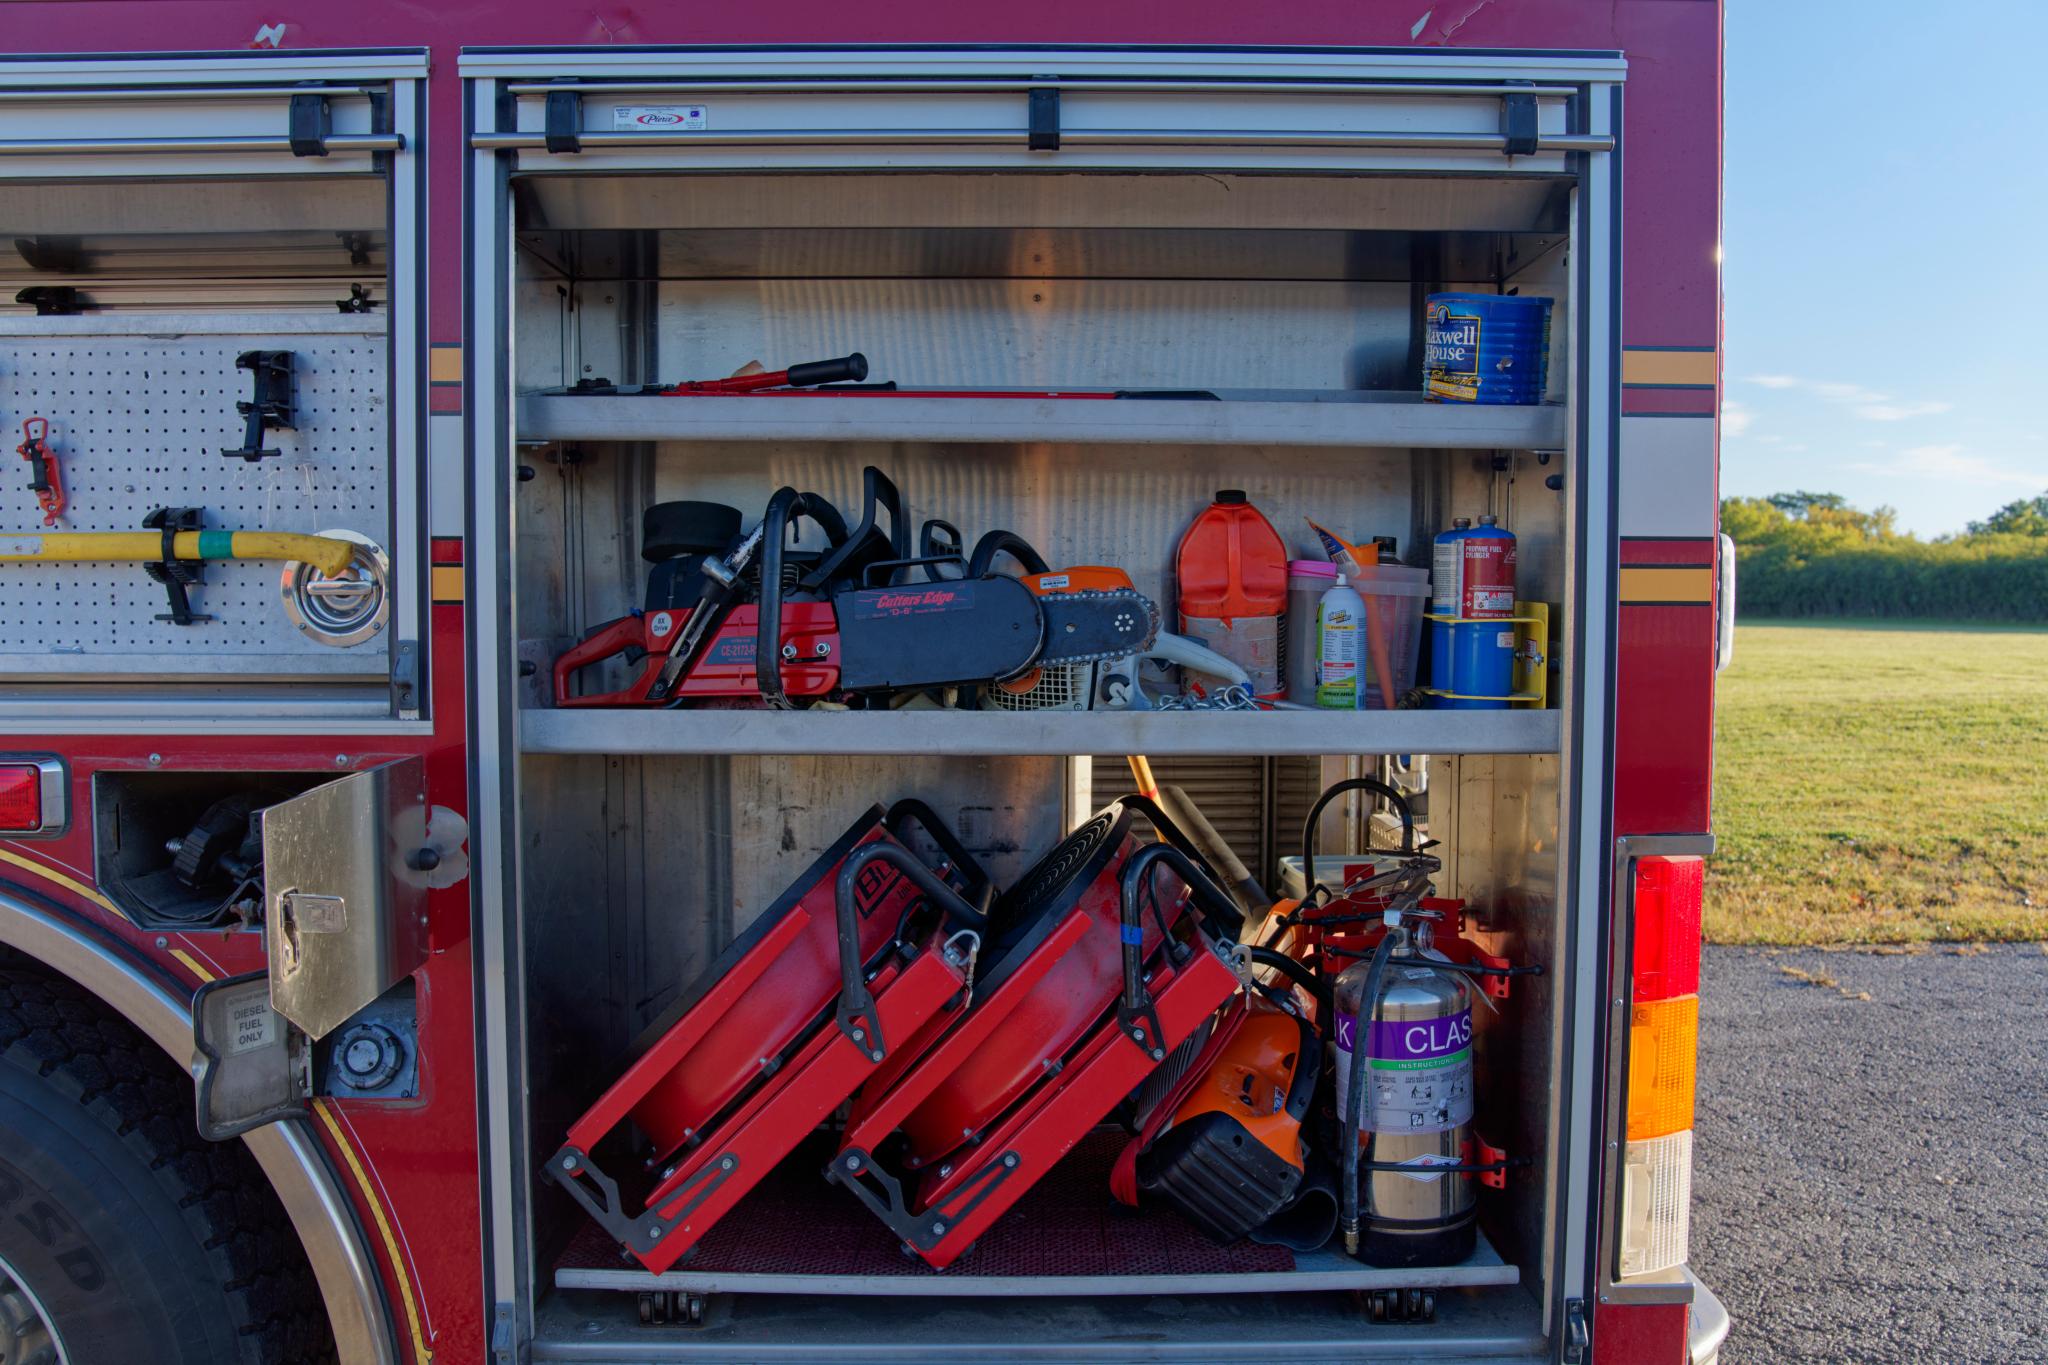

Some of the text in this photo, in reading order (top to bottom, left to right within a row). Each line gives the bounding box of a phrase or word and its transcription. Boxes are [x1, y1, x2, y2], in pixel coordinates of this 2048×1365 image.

[1426, 346, 1465, 362] House
[1490, 545, 1503, 553] FUEL
[924, 591, 955, 605] Edge
[234, 1003, 268, 1020] DIESEL
[239, 1018, 263, 1032] FUEL
[239, 1030, 263, 1046] ONLY
[1338, 1020, 1352, 1048] K
